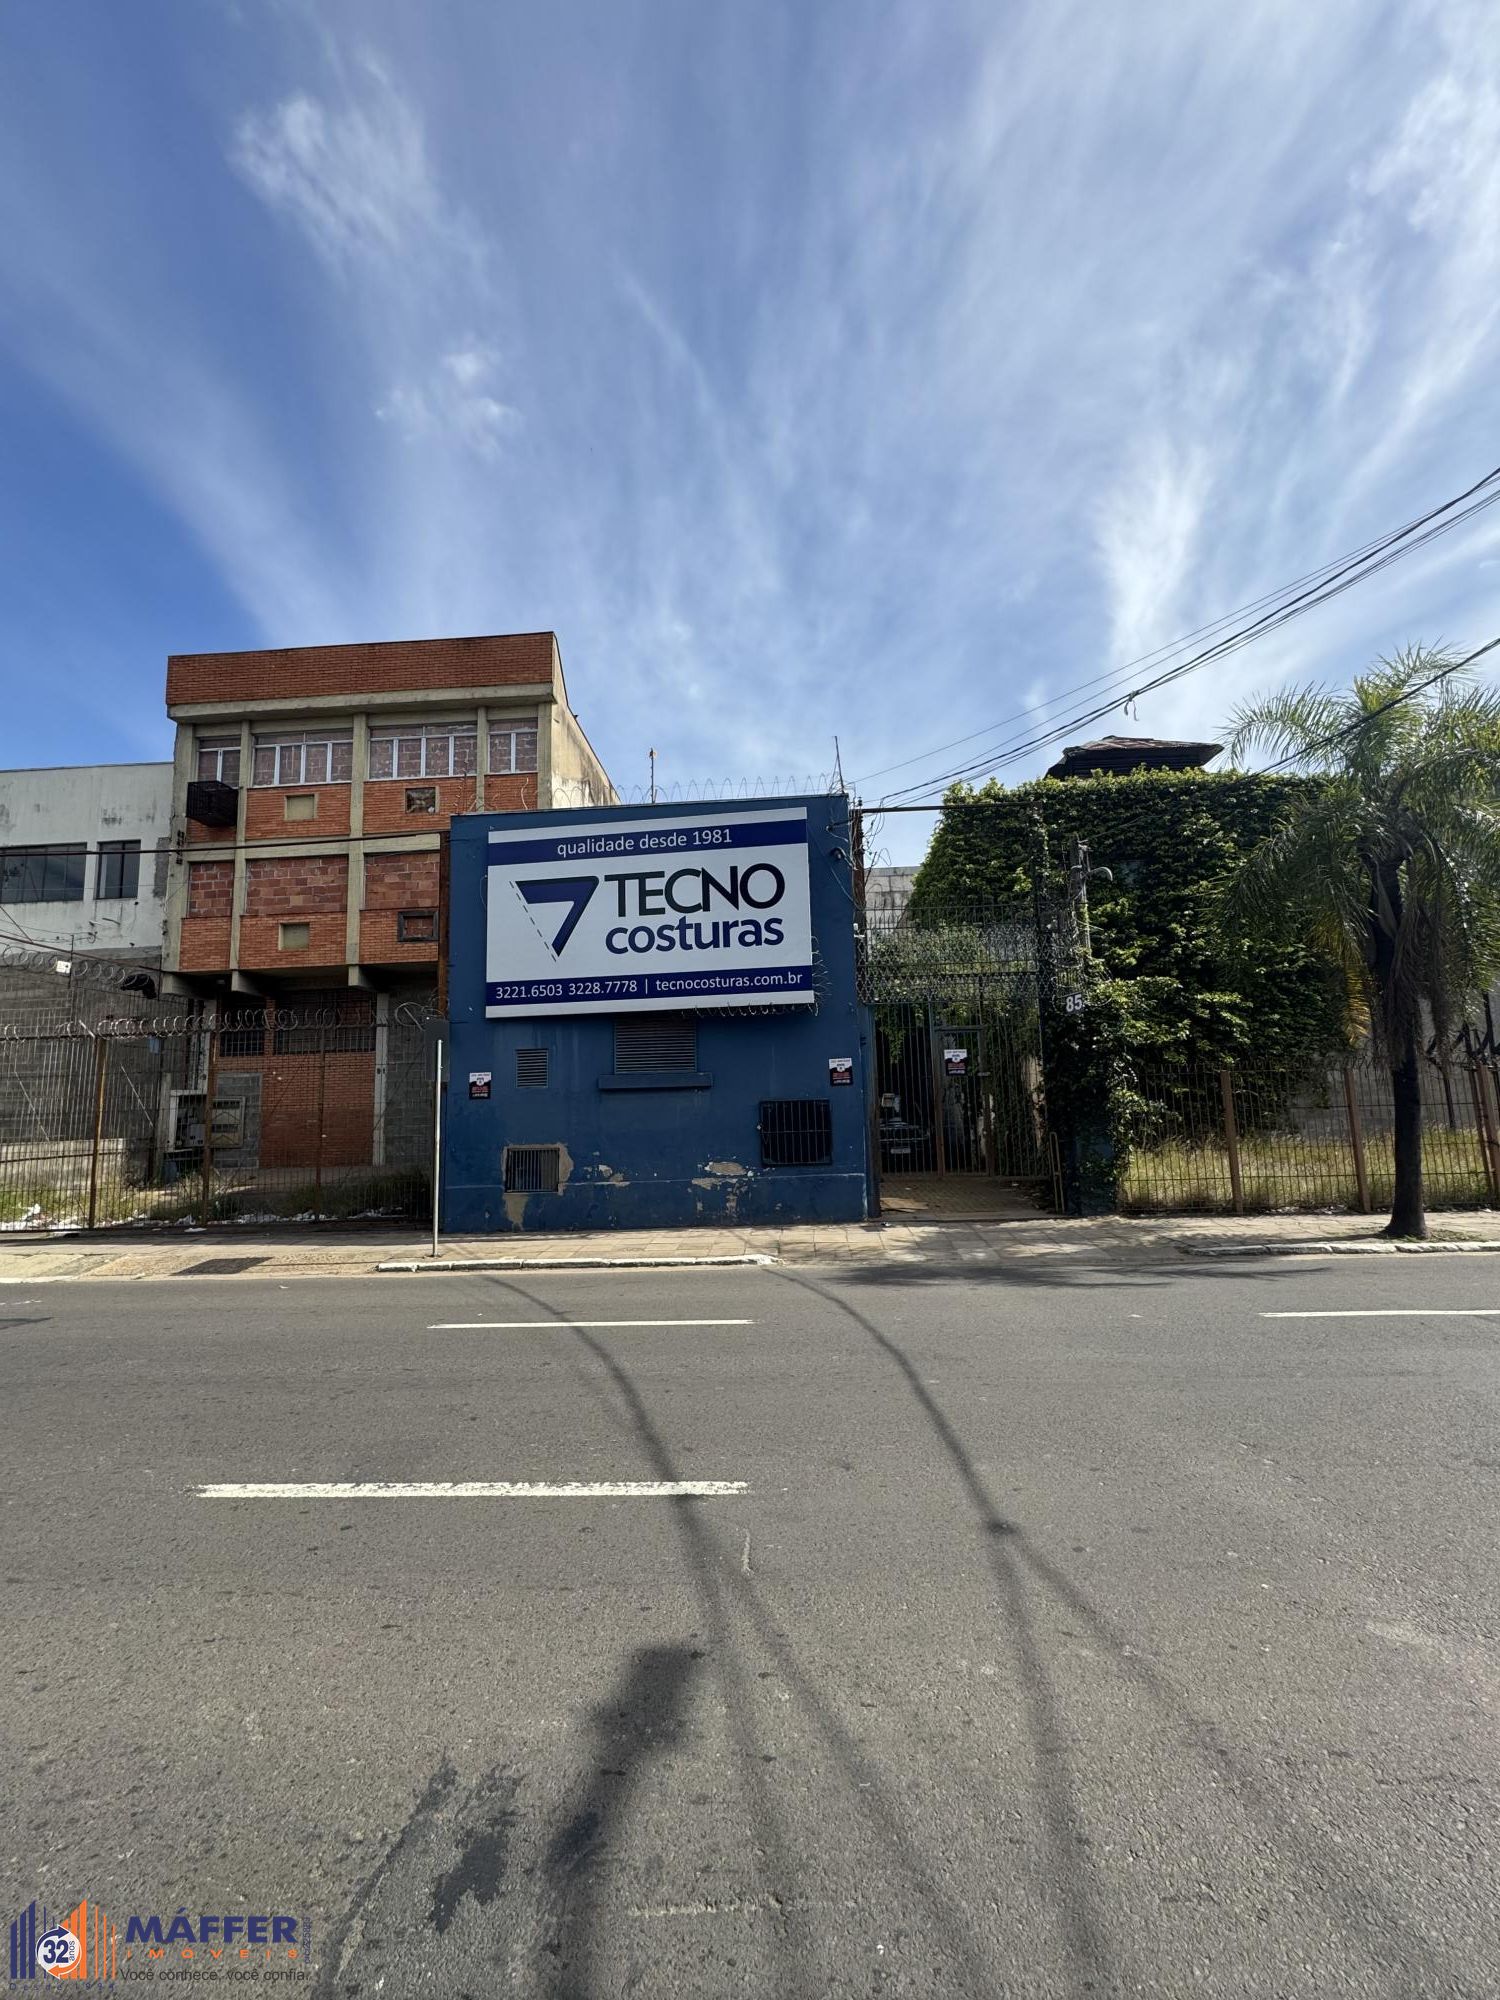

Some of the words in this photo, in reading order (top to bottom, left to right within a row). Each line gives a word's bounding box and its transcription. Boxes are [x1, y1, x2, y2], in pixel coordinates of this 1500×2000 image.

[557, 837, 634, 858] qualidade
[639, 832, 687, 850] desde
[692, 828, 732, 846] 1981
[604, 863, 785, 917] TECNO
[605, 915, 784, 955] costuras
[495, 985, 563, 999] 3221.6503
[568, 980, 638, 995] 3228.7778
[655, 972, 803, 991] tecnocosturas.com.br
